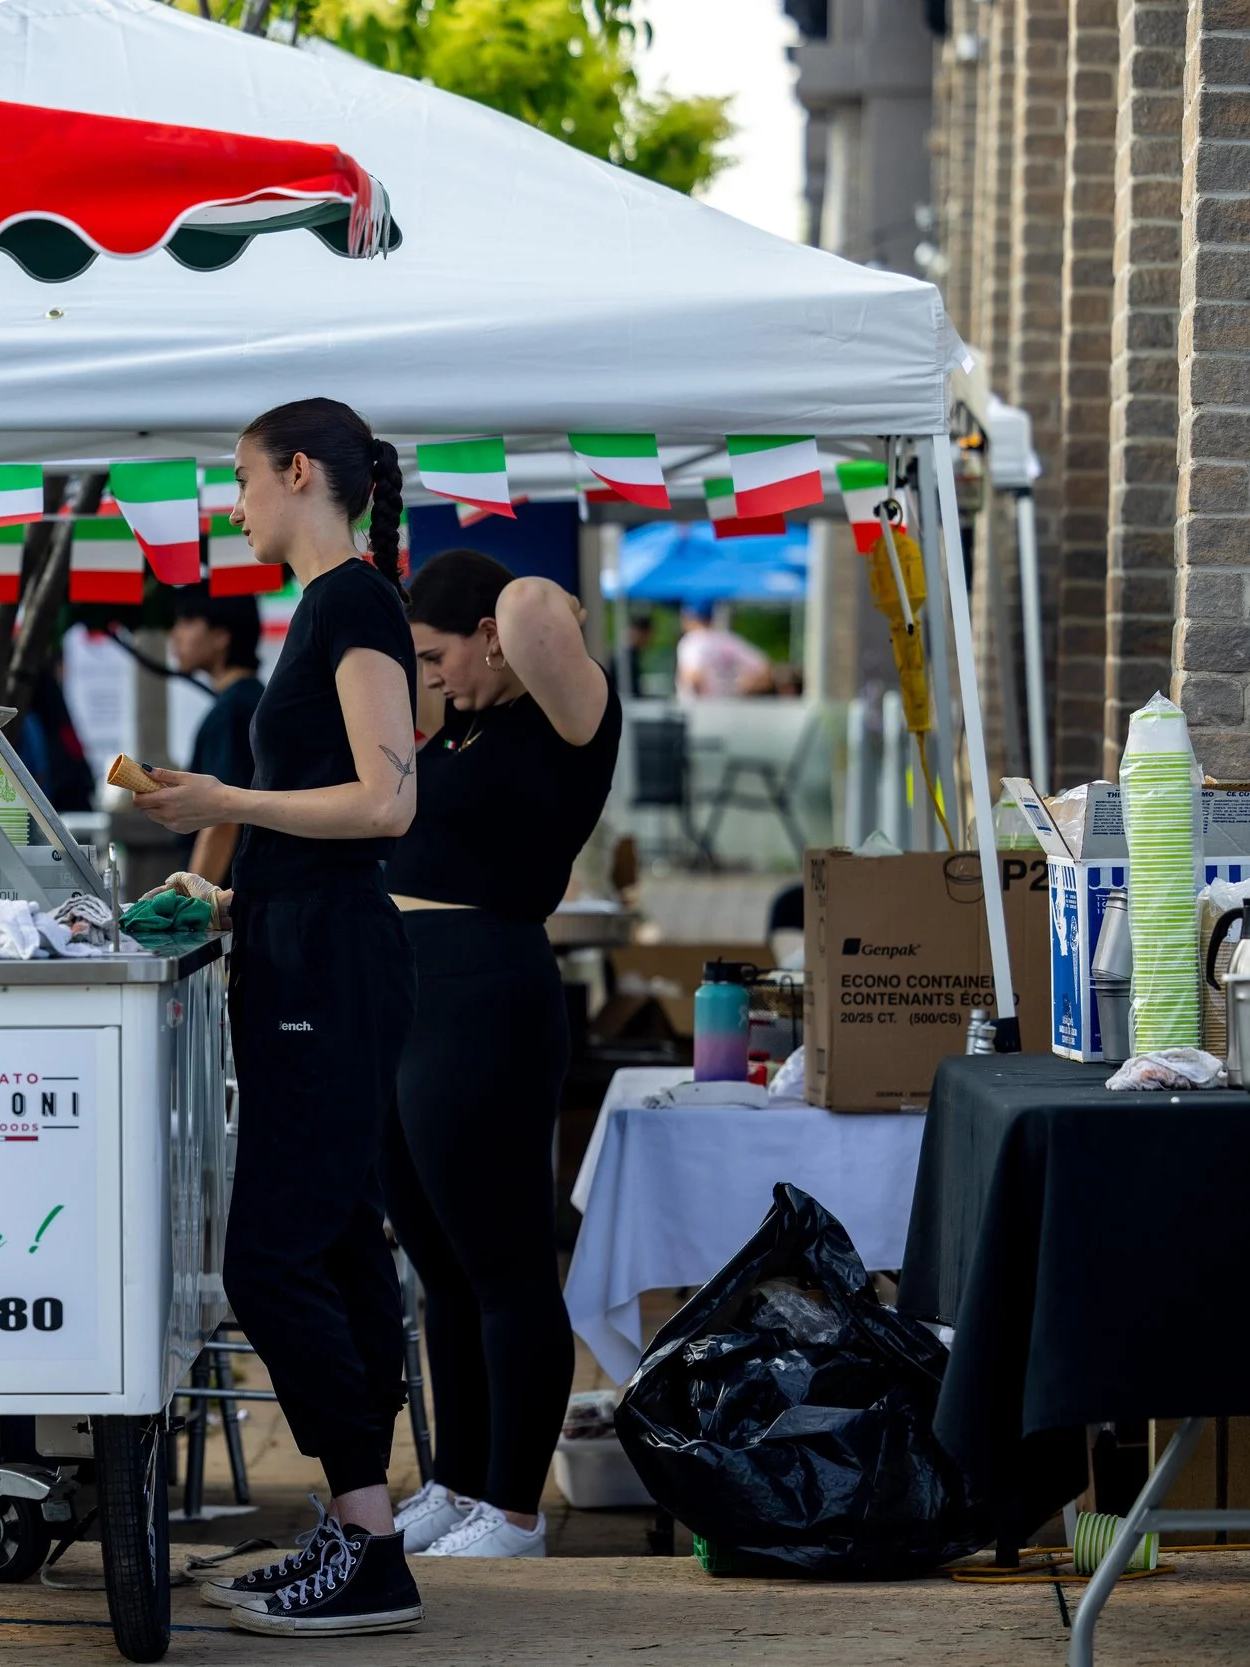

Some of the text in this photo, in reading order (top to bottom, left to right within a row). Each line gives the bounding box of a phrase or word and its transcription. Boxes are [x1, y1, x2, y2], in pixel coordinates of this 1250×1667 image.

[861, 943, 918, 960] Genpak
[841, 975, 901, 988] ECONO
[841, 992, 954, 1006] CONTENANTS
[841, 1012, 962, 1028] 20/25 CT. (500/CS)
